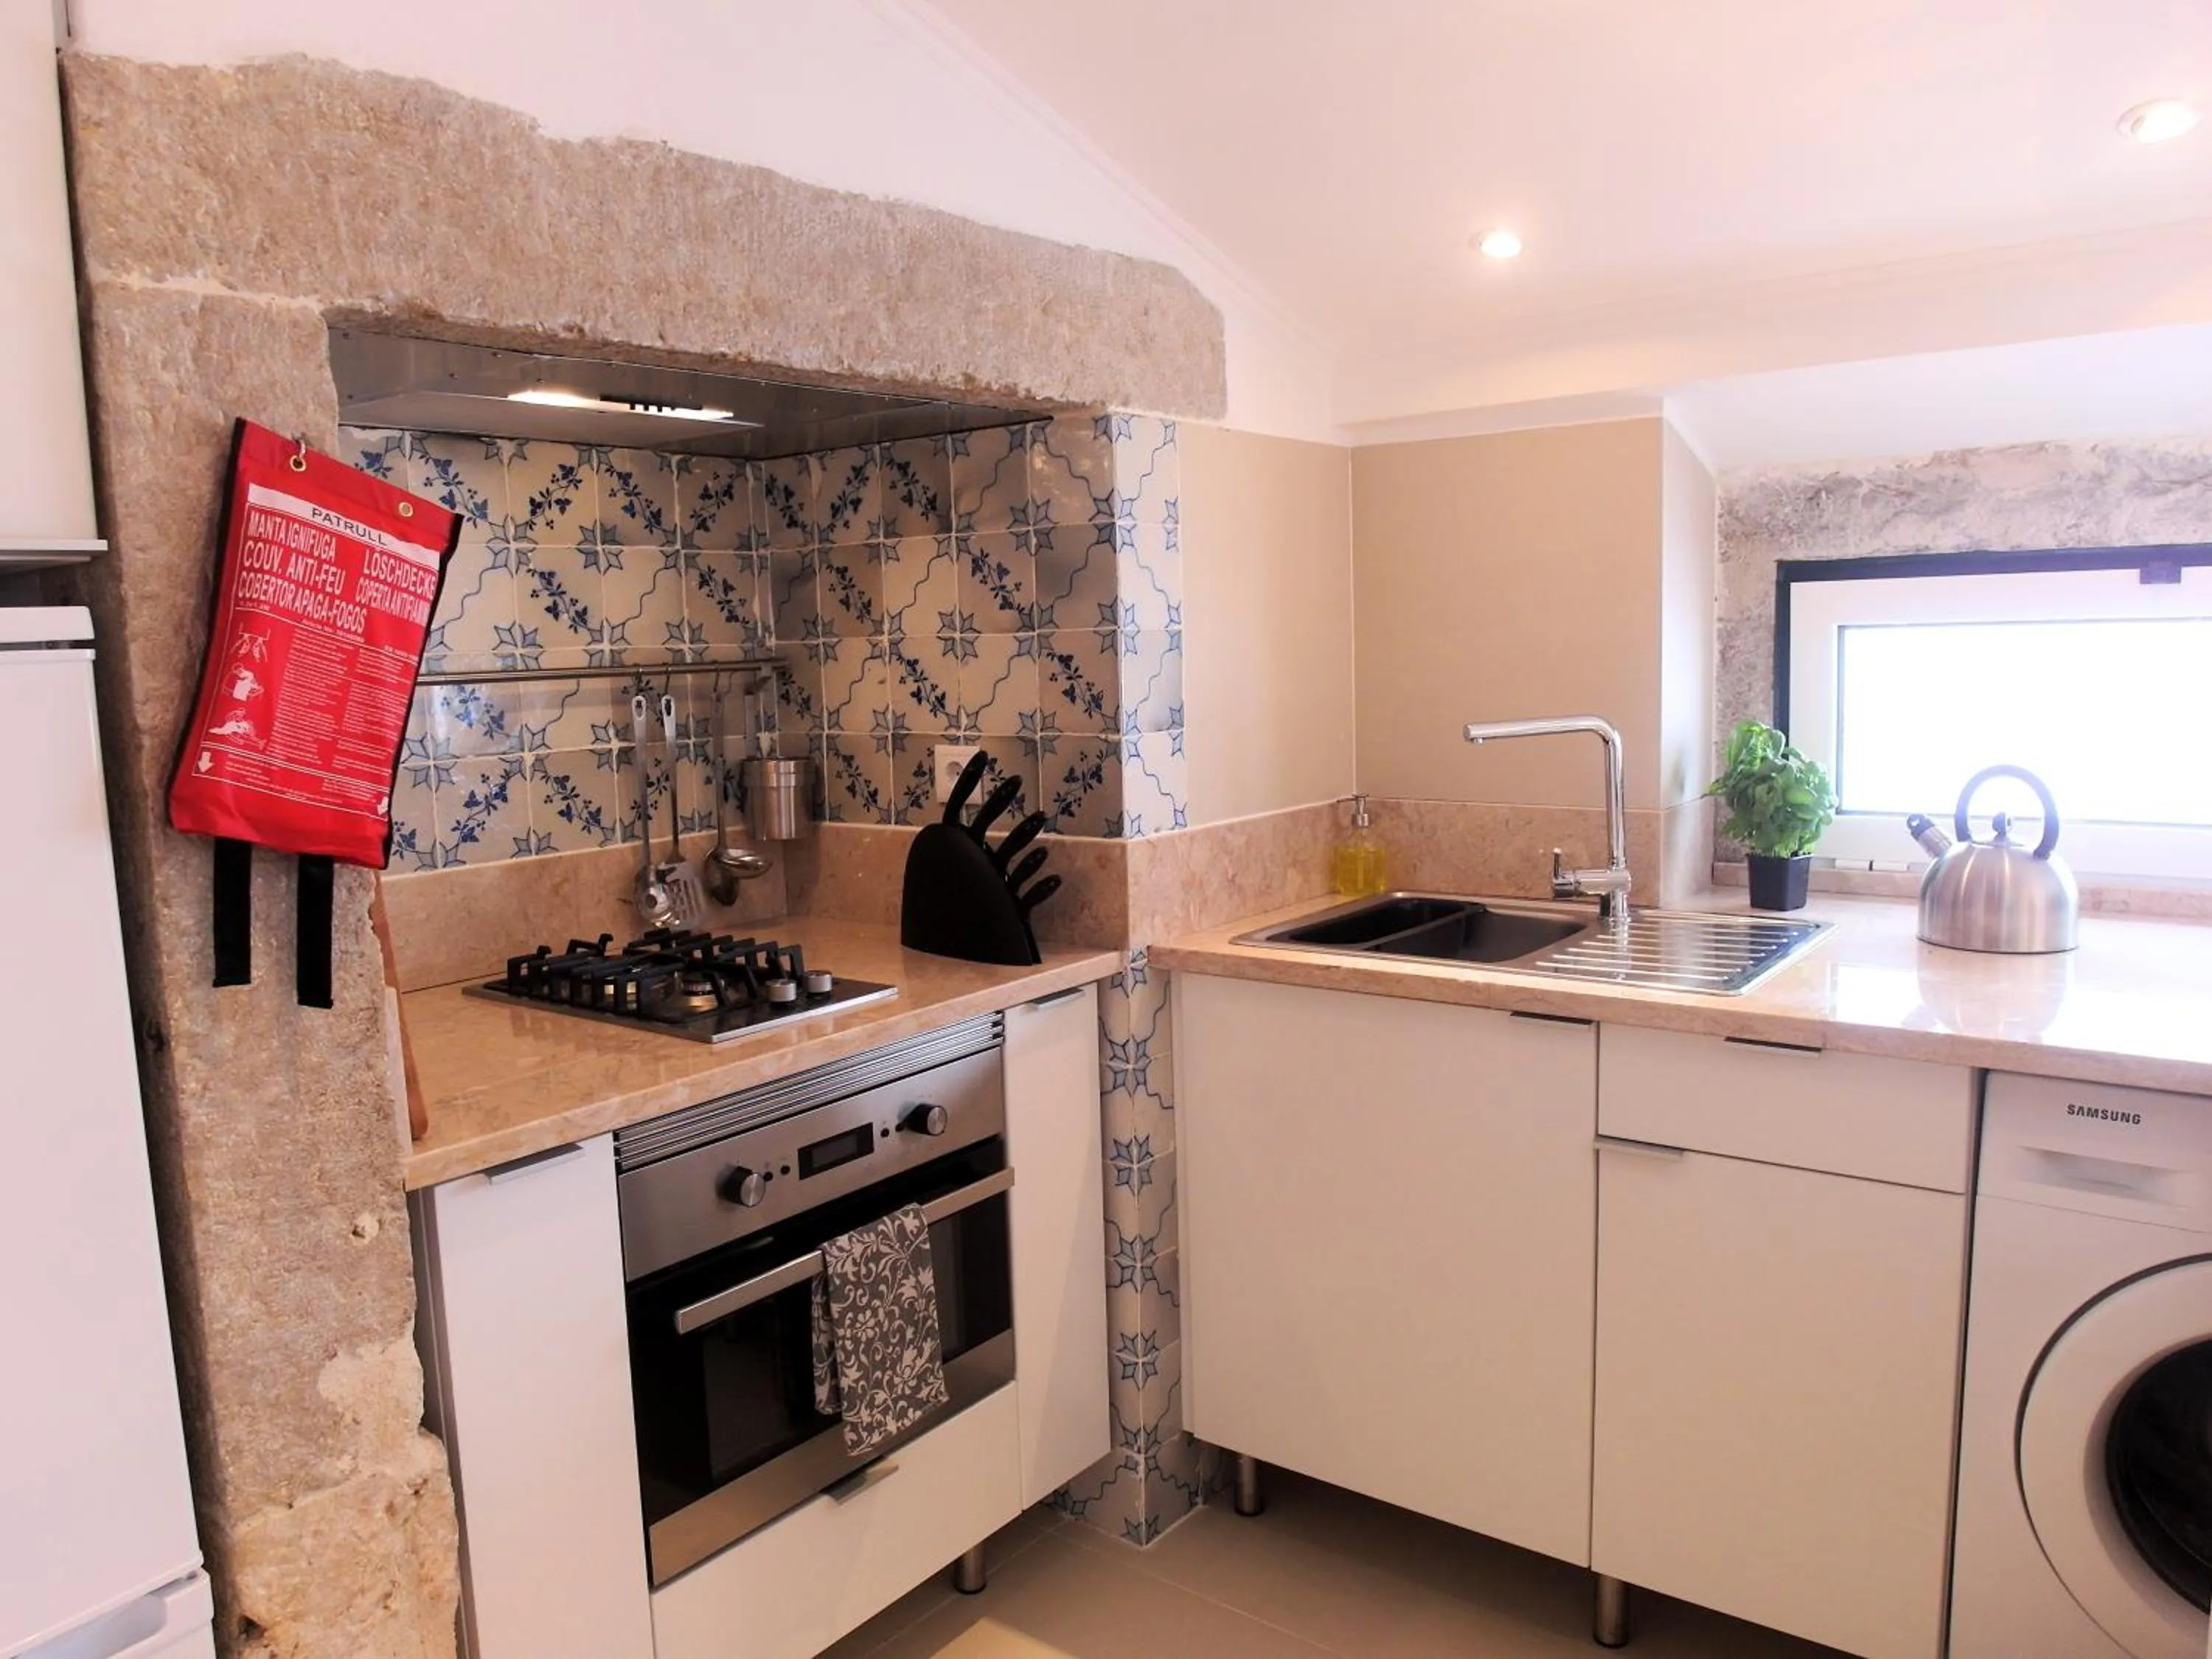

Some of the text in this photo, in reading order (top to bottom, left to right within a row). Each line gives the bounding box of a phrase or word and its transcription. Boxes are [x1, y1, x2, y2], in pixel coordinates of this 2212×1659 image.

[247, 510, 336, 562] MANTA IGNIFUGA
[311, 507, 387, 546] PATRULL
[243, 540, 346, 595] COUV. ANTI-FEU
[238, 571, 295, 610] COBERTOR
[293, 587, 367, 634] APAGA-FOGOS
[2067, 1103, 2142, 1125] SAMSUNG
